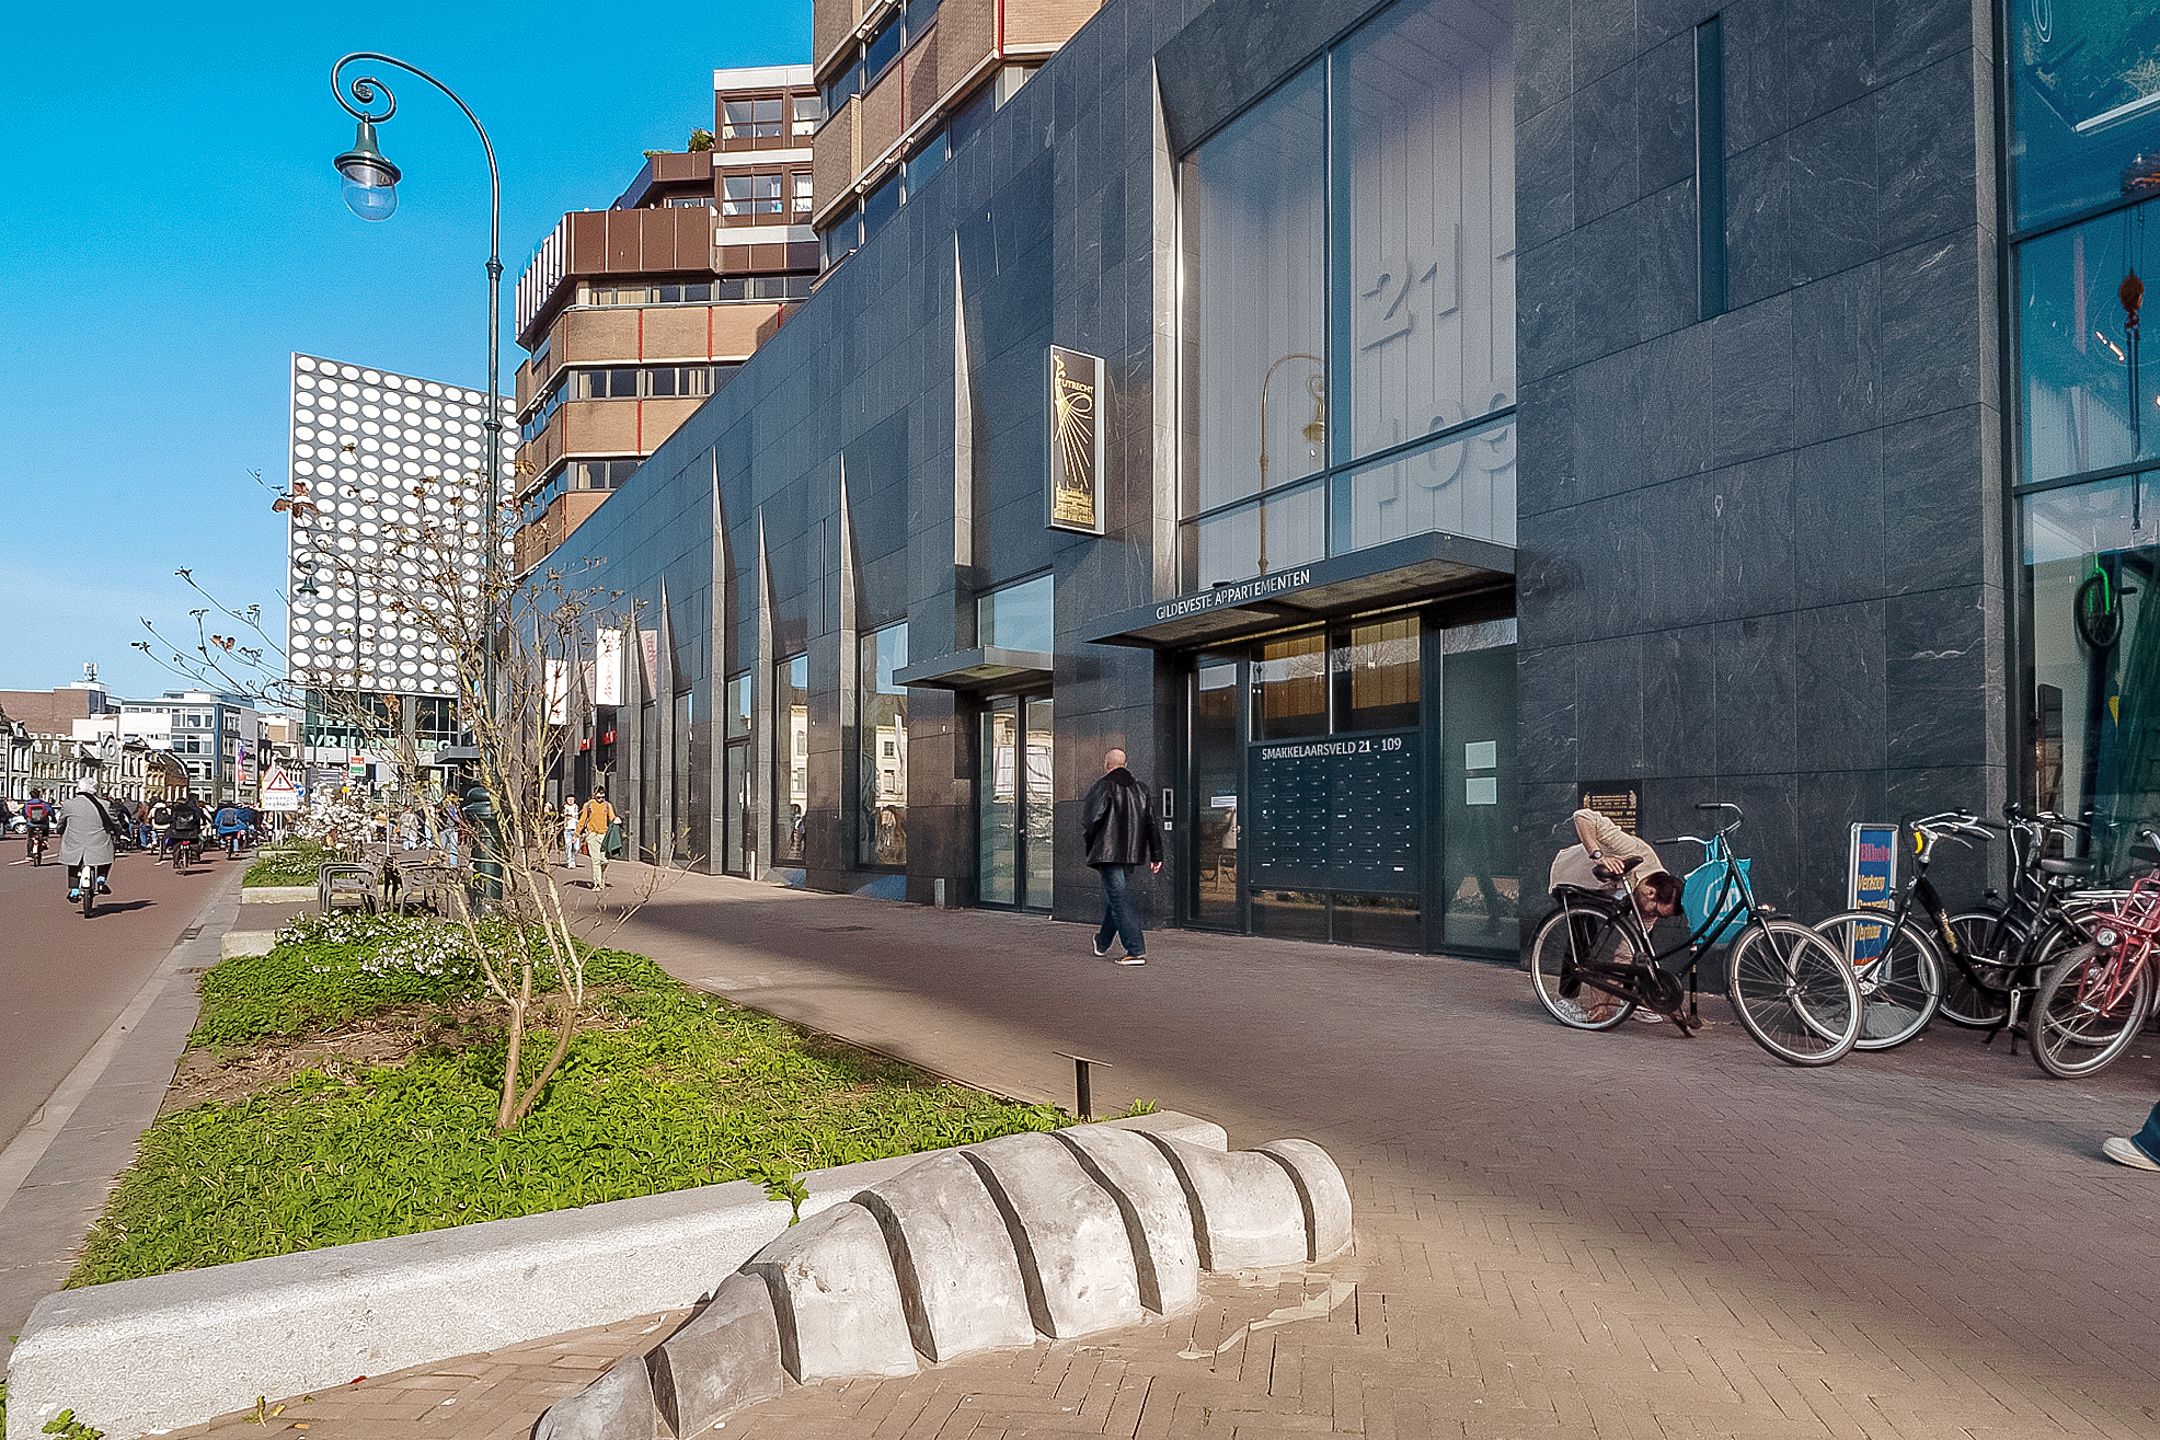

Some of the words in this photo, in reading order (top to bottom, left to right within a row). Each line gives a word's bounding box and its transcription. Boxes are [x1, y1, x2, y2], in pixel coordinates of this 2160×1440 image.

[1361, 223, 1460, 350] 21
[1062, 378, 1094, 395] UTRECHT
[1156, 593, 1213, 620] GILDEVESTE
[1214, 568, 1310, 606] APPARTEMENTEN
[1262, 741, 1356, 760] SMAKKELAARSVELD
[1358, 740, 1371, 753] 21
[1381, 738, 1402, 751] 109
